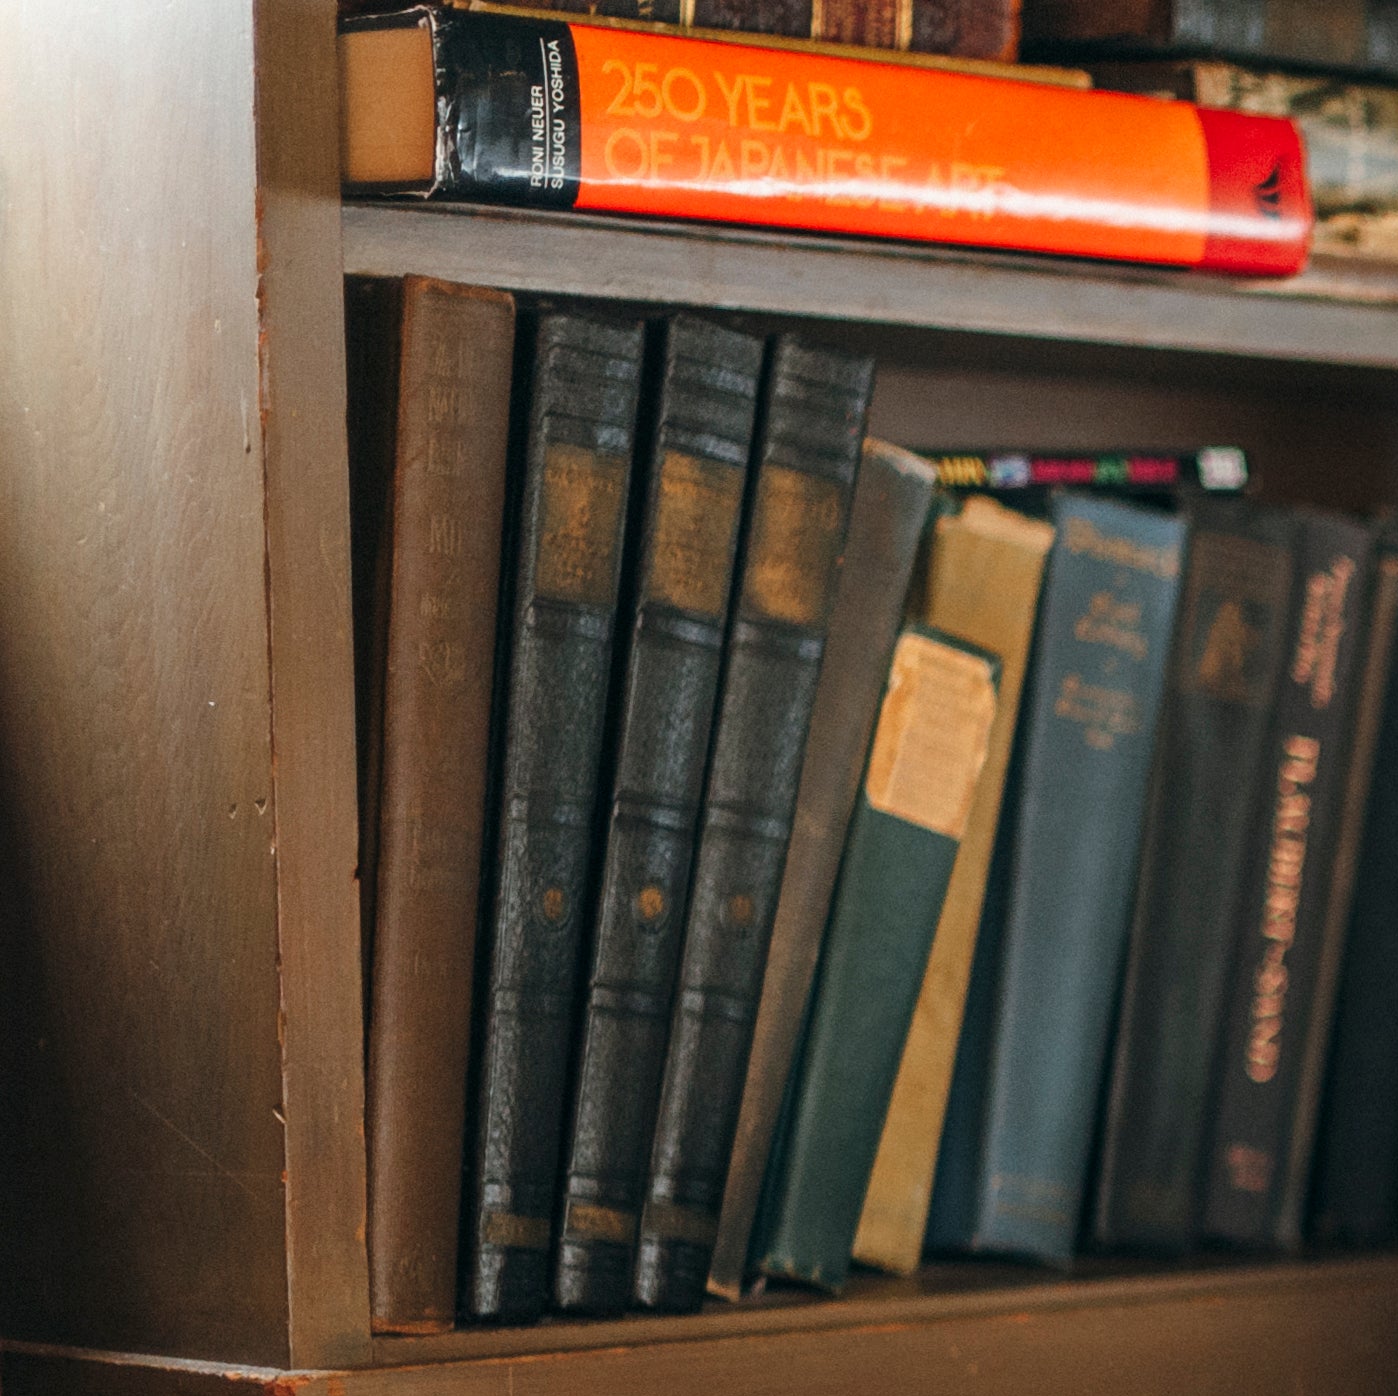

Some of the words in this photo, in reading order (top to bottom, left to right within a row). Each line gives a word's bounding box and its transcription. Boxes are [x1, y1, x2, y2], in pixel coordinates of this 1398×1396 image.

[547, 40, 565, 113] YOSHIDA
[602, 59, 706, 122] 250
[714, 71, 873, 141] YEARS
[531, 85, 544, 141] NEUER
[531, 146, 544, 187] RONI
[551, 119, 566, 189] SUSUGU
[604, 127, 680, 183] OF
[690, 134, 908, 212] JAPANESE
[916, 162, 1008, 223] ART
